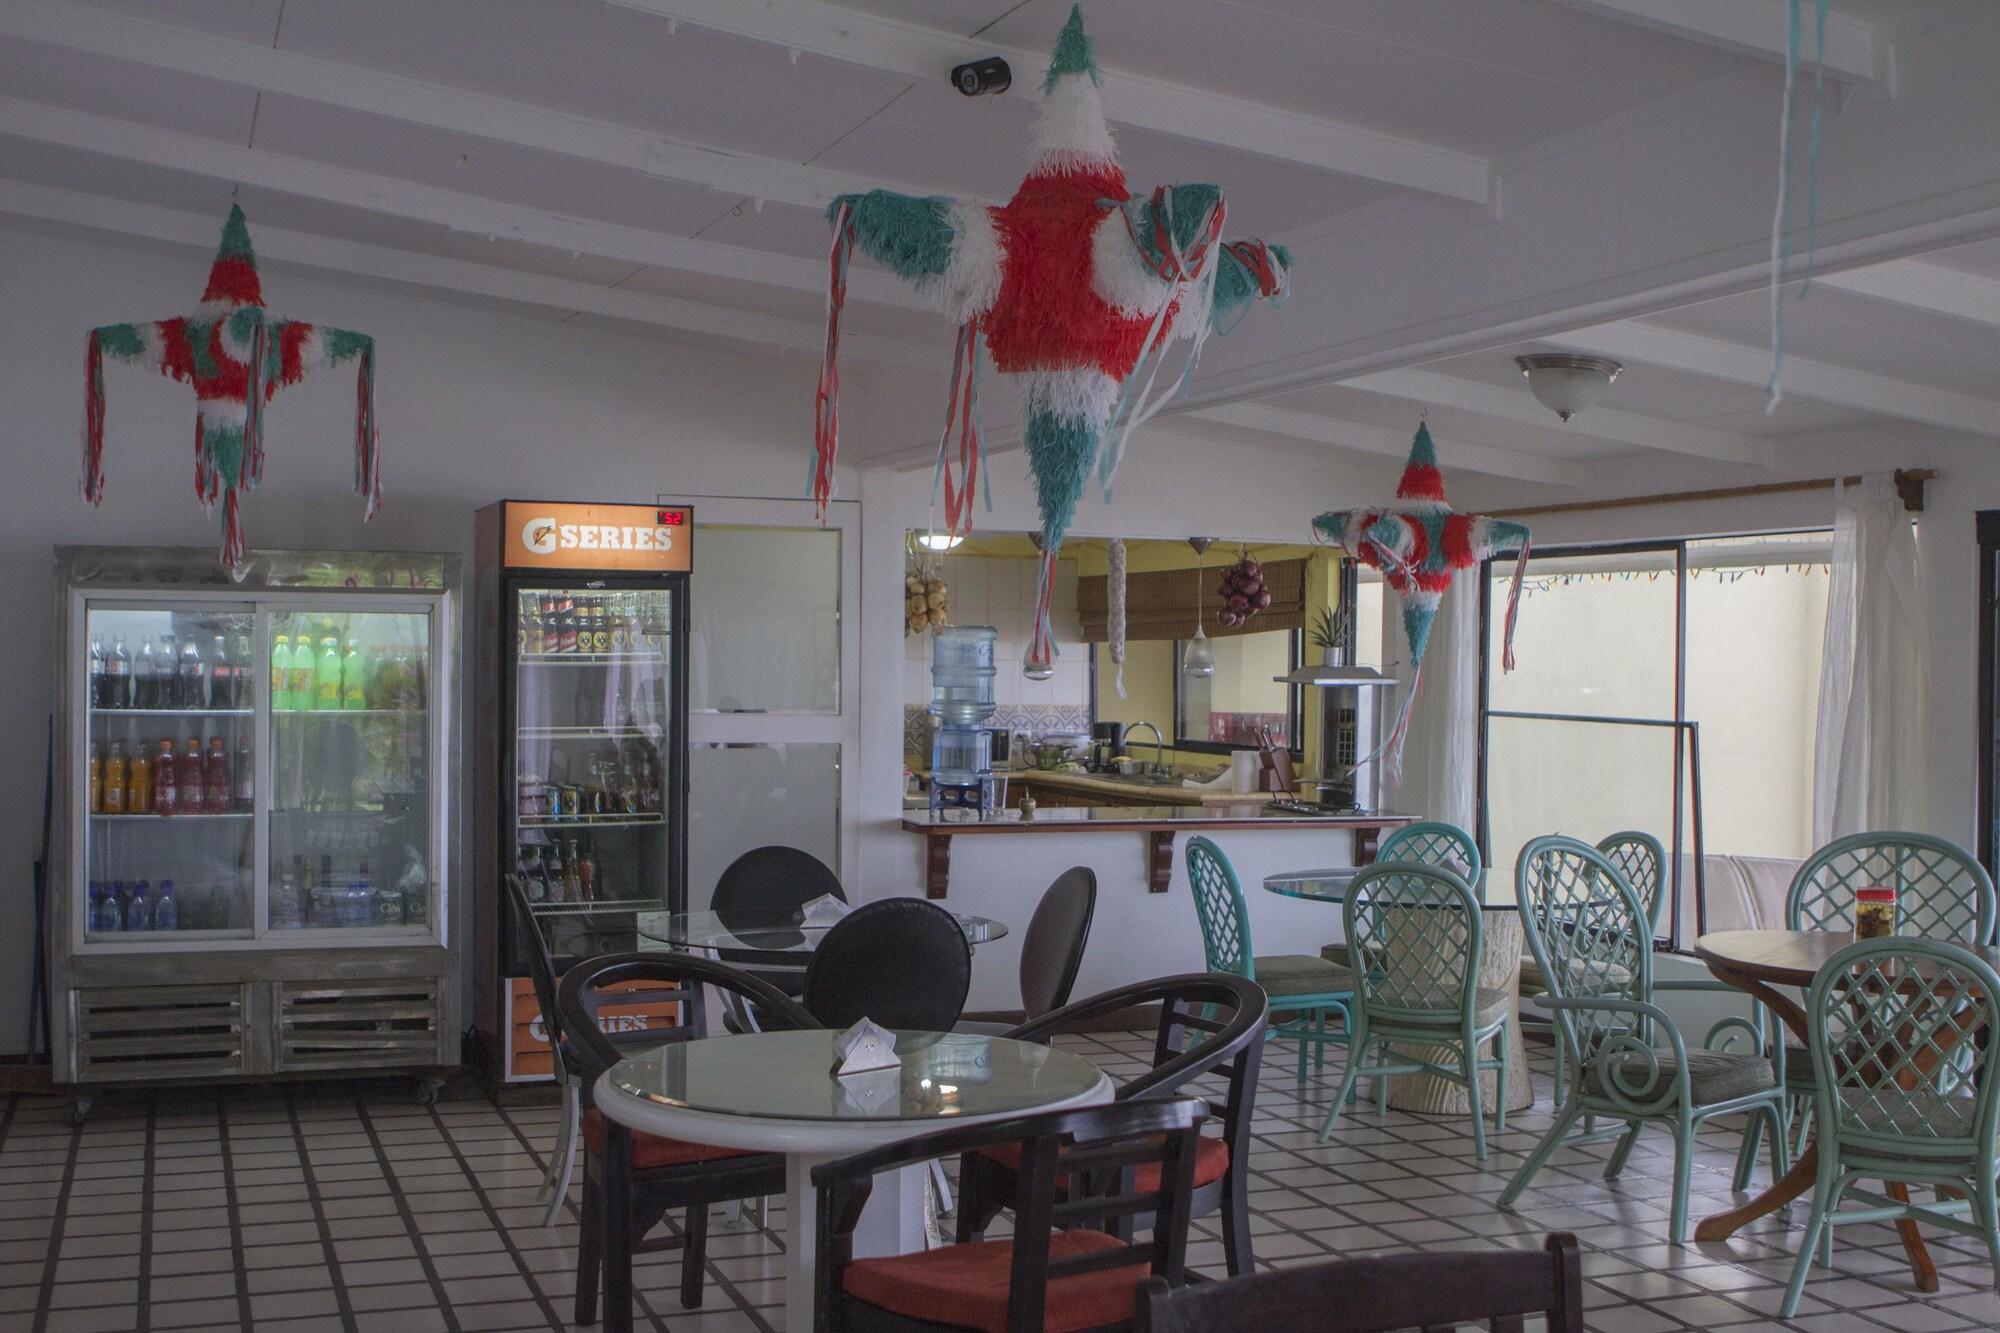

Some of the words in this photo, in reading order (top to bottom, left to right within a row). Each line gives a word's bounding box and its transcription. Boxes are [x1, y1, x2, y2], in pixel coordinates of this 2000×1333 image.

[522, 517, 556, 554] G
[559, 525, 673, 552] SERIES
[410, 902, 426, 913] Clo
